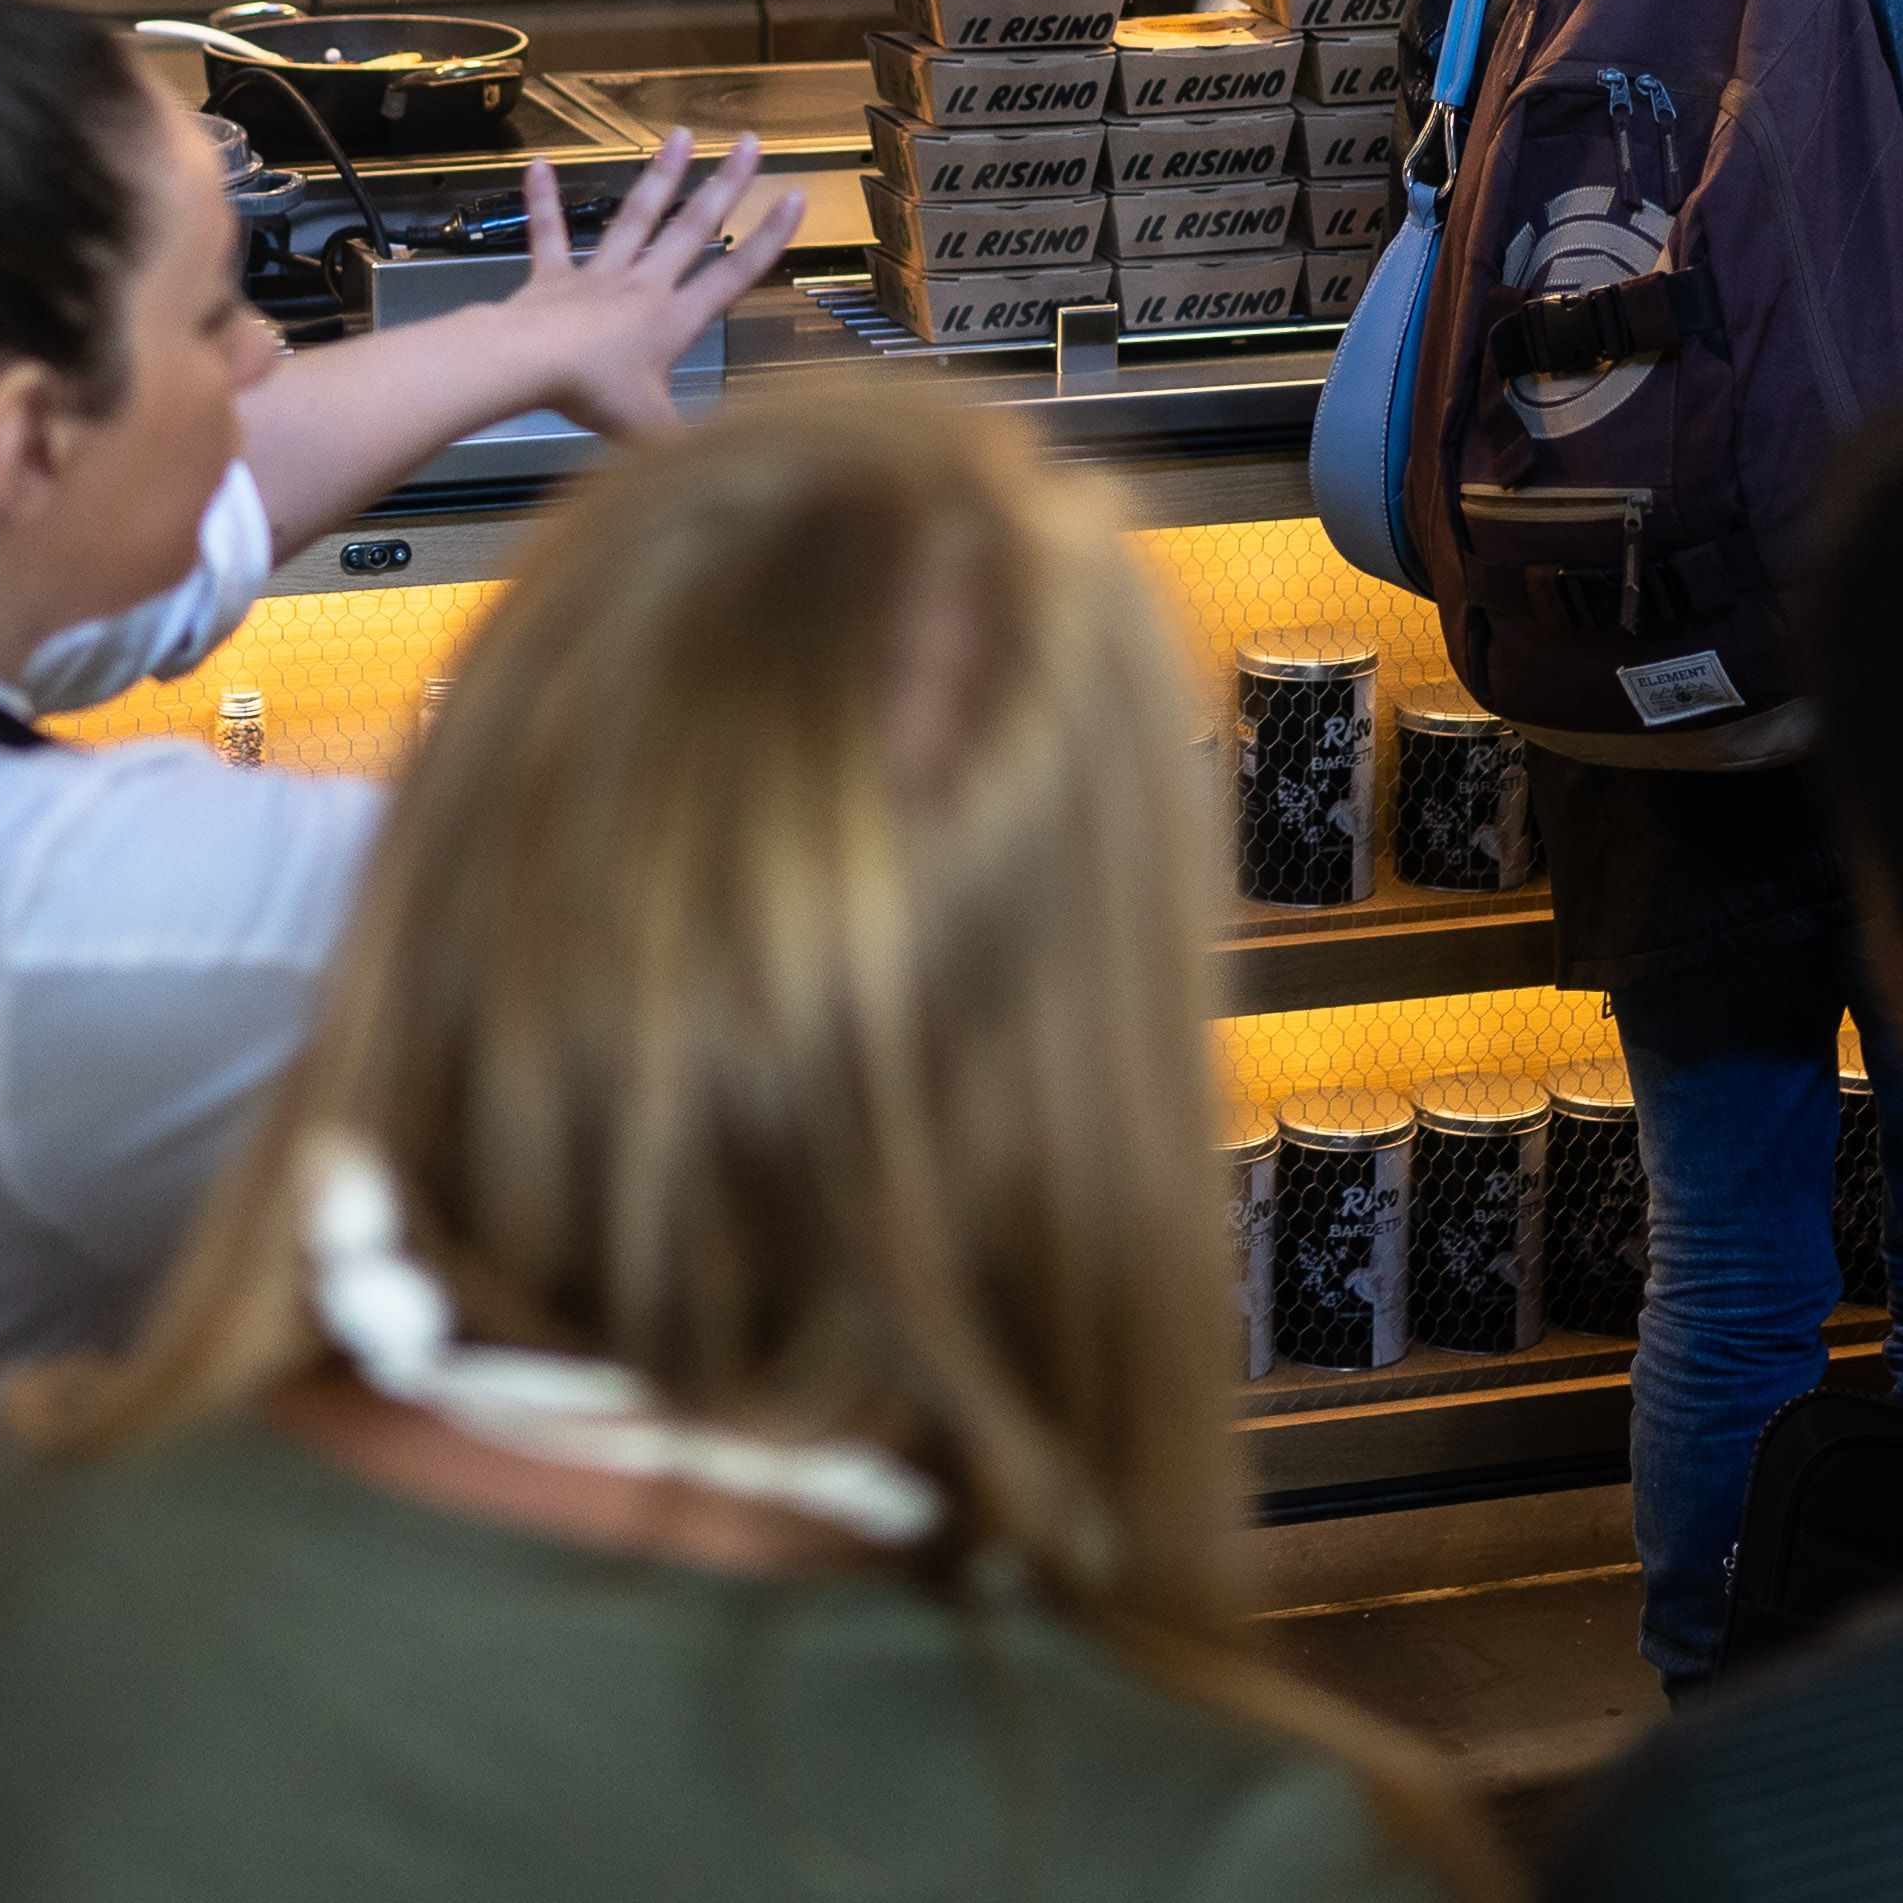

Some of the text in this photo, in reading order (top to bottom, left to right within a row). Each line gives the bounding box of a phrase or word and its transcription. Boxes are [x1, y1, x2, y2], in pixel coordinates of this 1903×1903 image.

[958, 12, 1115, 45] IL RISINO
[944, 79, 1099, 114] IL RISINO
[1135, 69, 1287, 107] IL RISINO
[1329, 67, 1362, 95] IL
[1121, 144, 1276, 182] IL RISINO
[1324, 137, 1356, 166] IL
[930, 158, 1088, 193] IL RISINO
[1134, 205, 1286, 244] IL RISINO
[1324, 208, 1358, 236] IL
[934, 224, 1090, 259] IL RISINO
[1135, 285, 1286, 325] IL RISINO
[1320, 275, 1353, 304] IL
[942, 304, 974, 333] IL
[1637, 664, 1707, 687] ELEMENT
